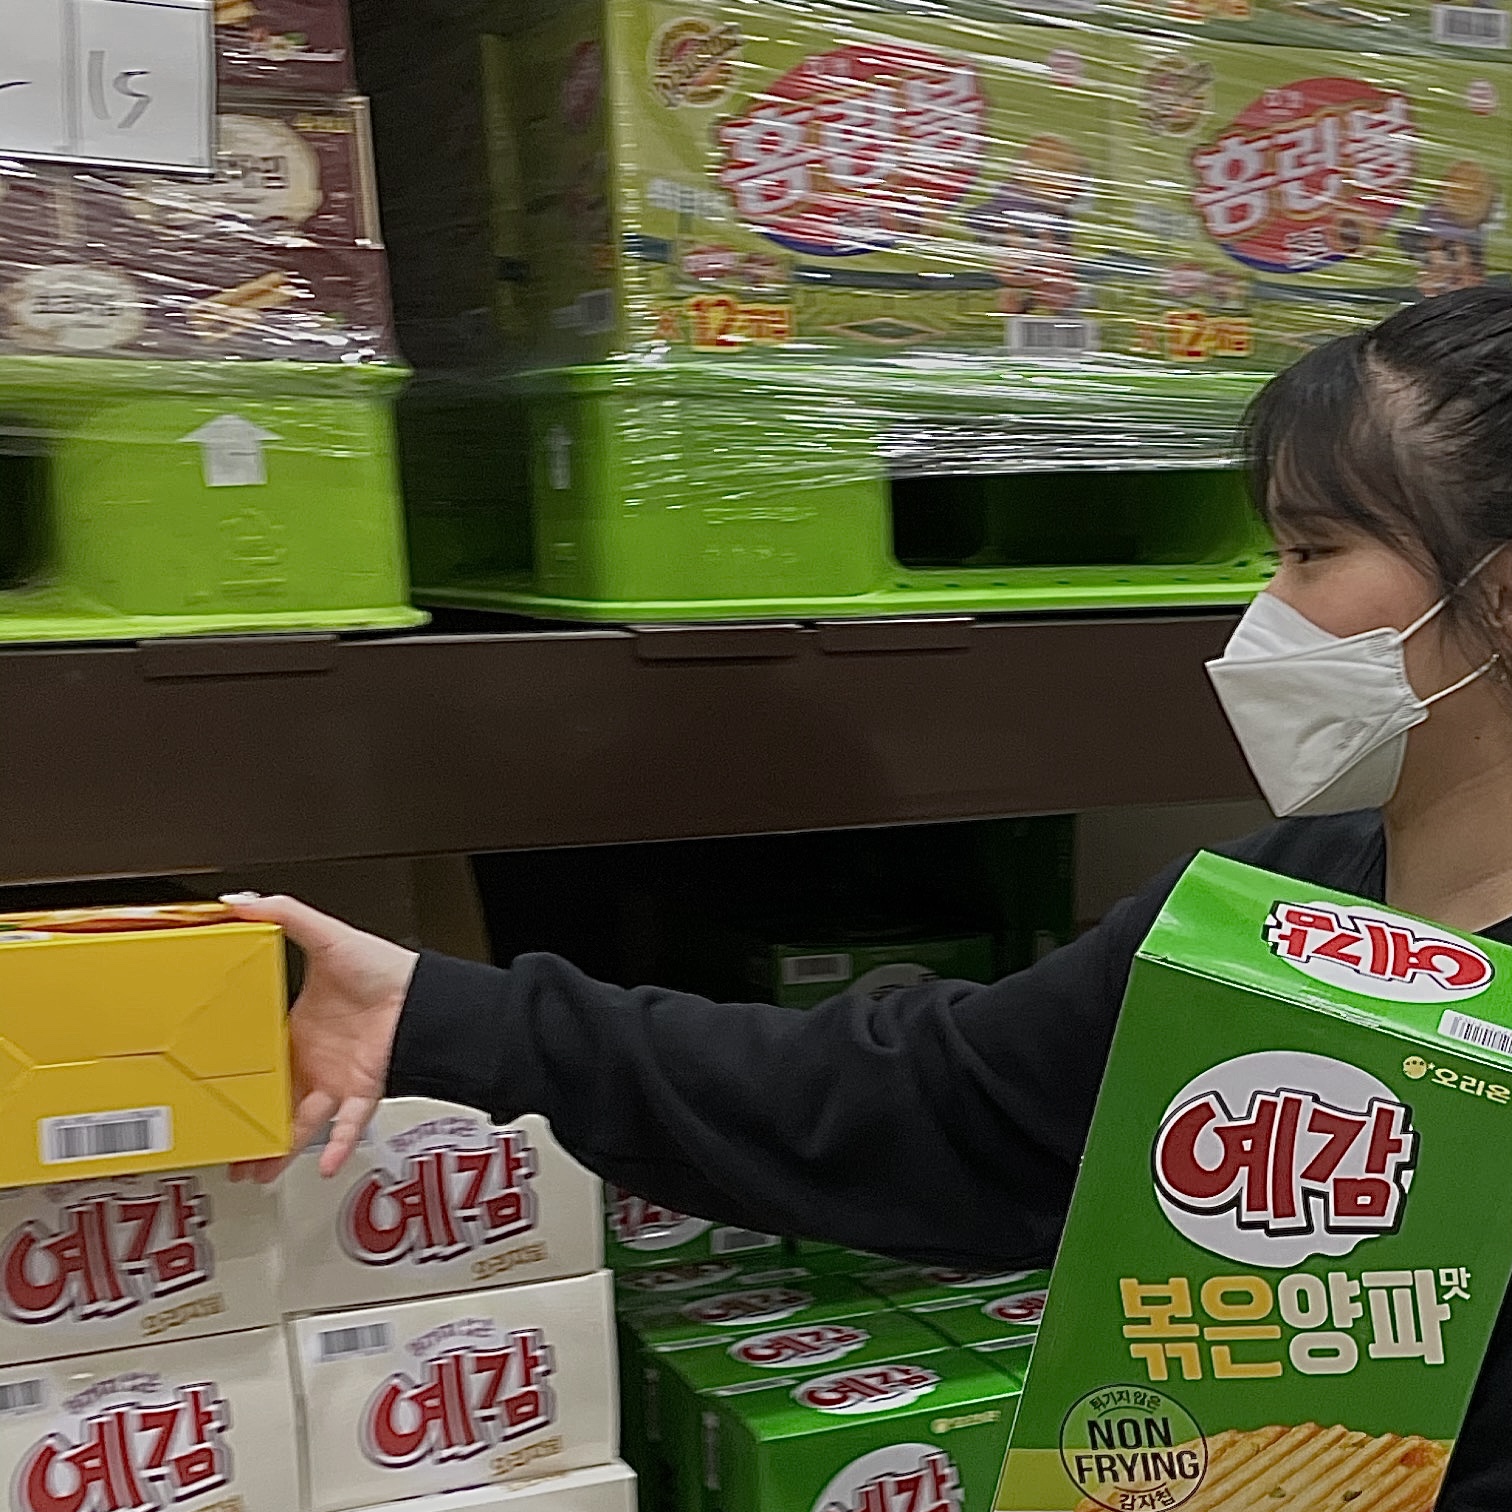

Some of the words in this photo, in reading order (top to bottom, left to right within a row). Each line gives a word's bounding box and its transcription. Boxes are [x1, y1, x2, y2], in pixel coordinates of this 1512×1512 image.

[1265, 900, 1495, 992] 예감
[1430, 1068, 1512, 1105] 오리온
[338, 1129, 540, 1267] 예감
[1152, 1089, 1420, 1237] 예감
[0, 1176, 214, 1326] 예감
[359, 1326, 557, 1469] 예감
[797, 1362, 943, 1410] 예감
[1074, 1450, 1201, 1485] FRYING
[1087, 1416, 1173, 1451] NON
[1119, 1487, 1176, 1511] 감자칩
